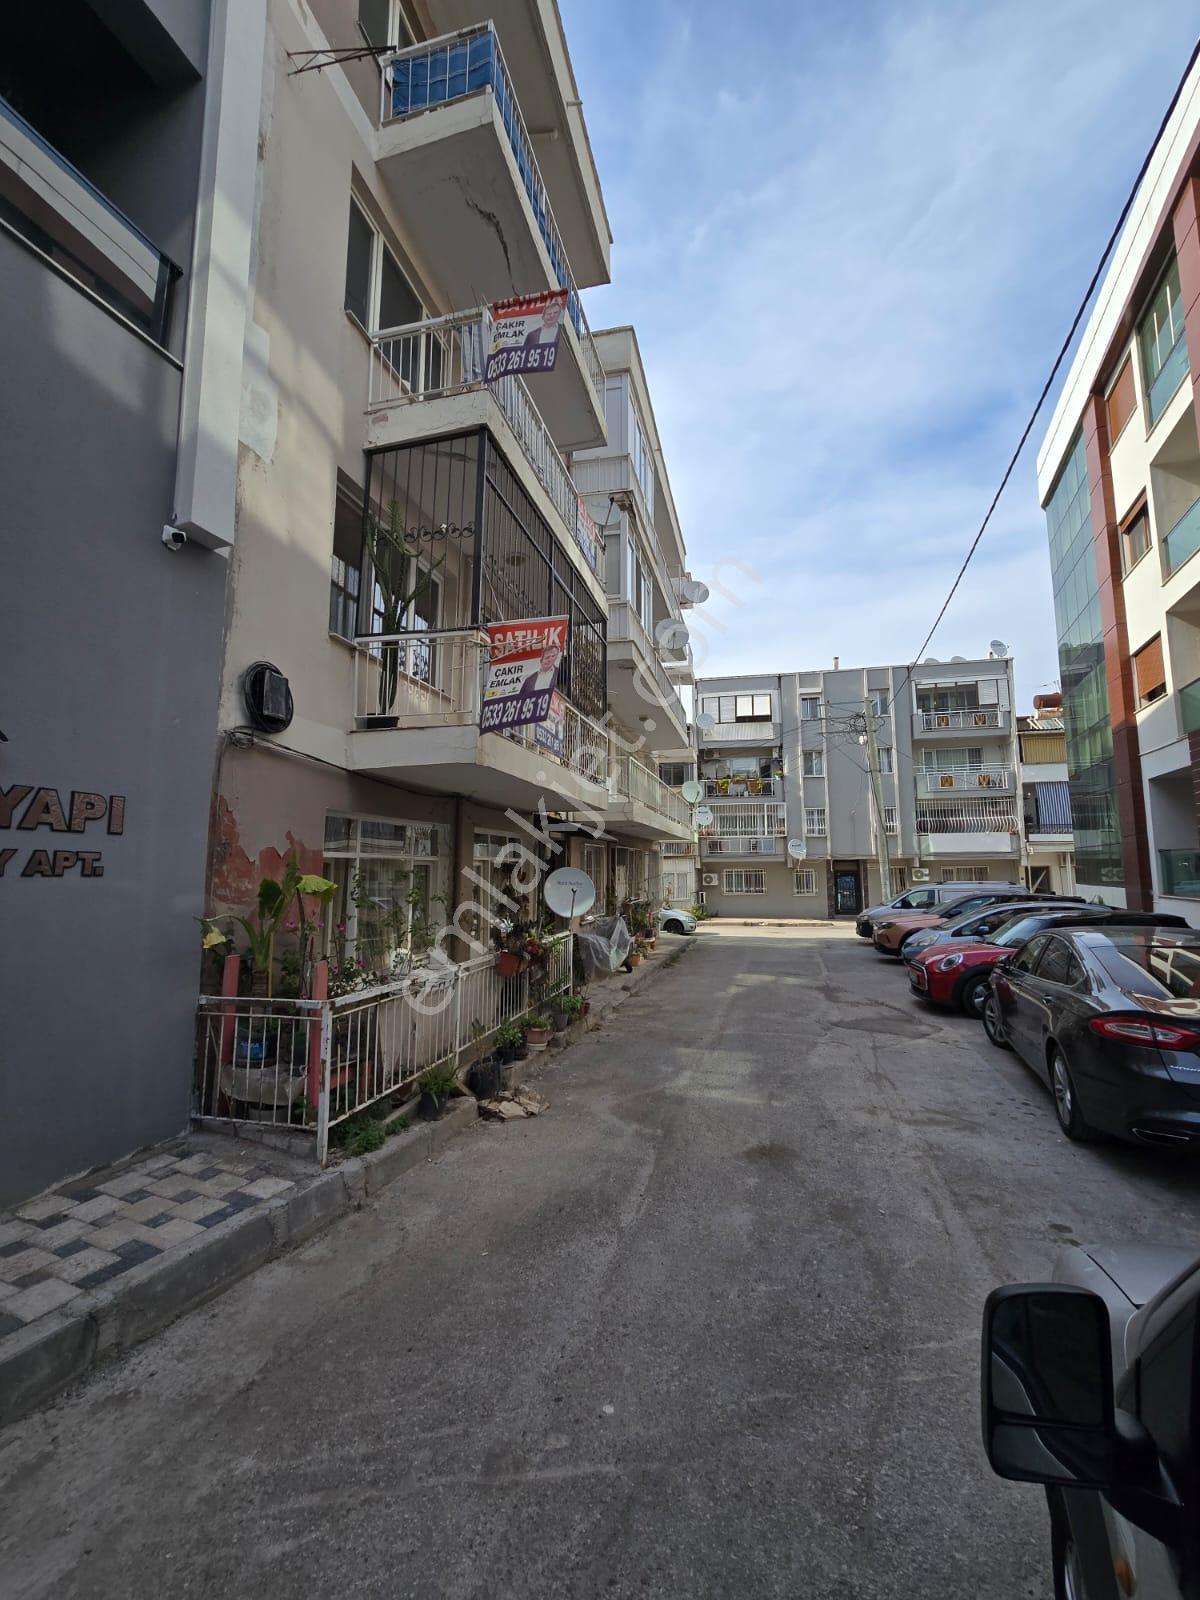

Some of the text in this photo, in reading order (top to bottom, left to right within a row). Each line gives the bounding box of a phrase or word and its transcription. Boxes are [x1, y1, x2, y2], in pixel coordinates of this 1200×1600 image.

[494, 330, 524, 342] EMLAK
[487, 347, 555, 379] 0533 261 95 19
[494, 626, 562, 657] SATILIK
[489, 677, 521, 688] EMLAK
[495, 665, 524, 678] ÇAKIR
[481, 702, 503, 728] 0533
[502, 700, 521, 723] 261
[521, 698, 536, 720] 95
[536, 693, 549, 717] 19
[20, 849, 104, 877] APT.
